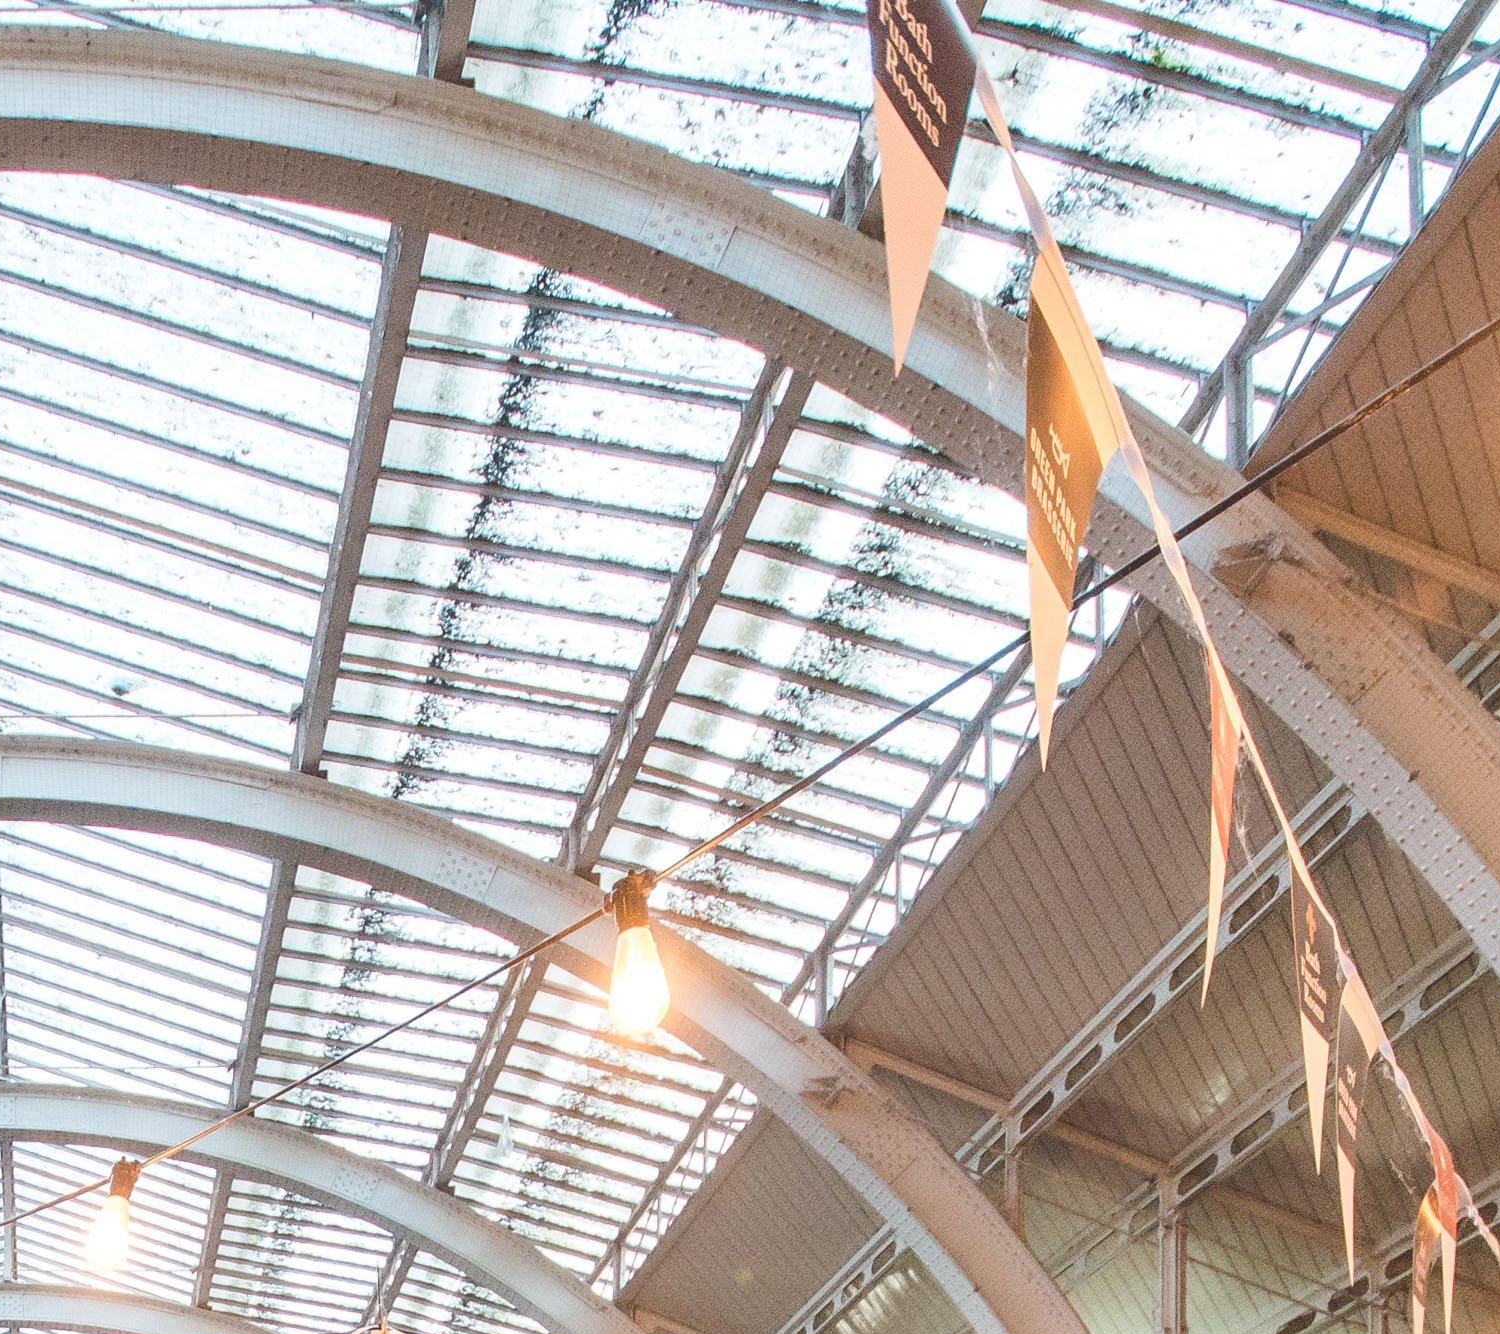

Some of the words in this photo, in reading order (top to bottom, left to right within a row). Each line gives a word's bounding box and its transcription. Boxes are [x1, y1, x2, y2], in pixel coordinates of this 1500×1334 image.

[885, 38, 940, 147] Rooms
[1030, 427, 1055, 496] GREEN
[1056, 486, 1077, 543] PARK
[1031, 464, 1074, 570] BRASSERIE
